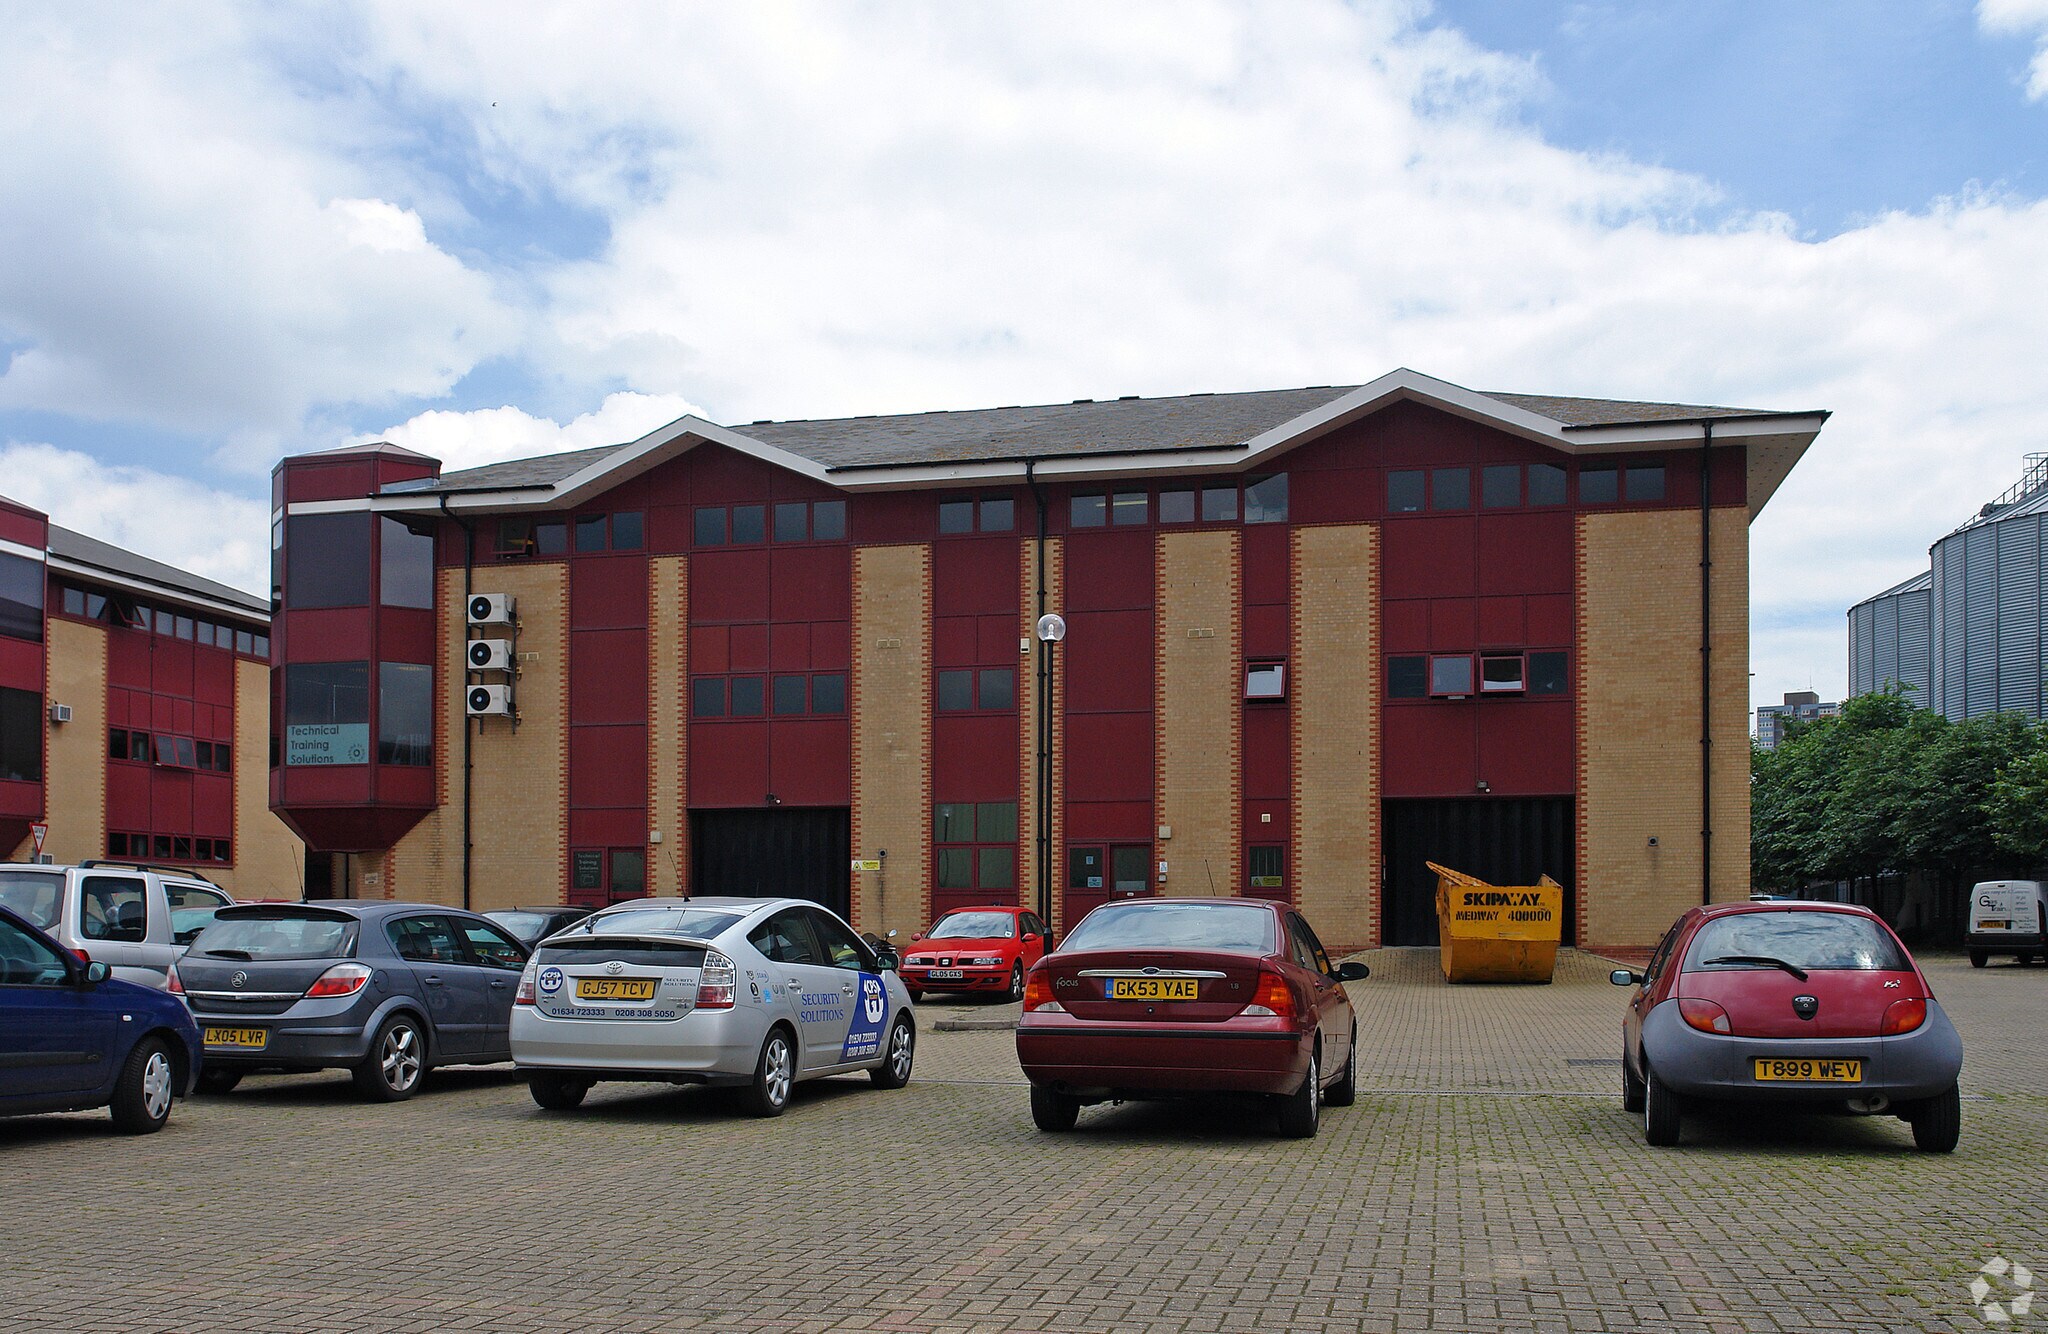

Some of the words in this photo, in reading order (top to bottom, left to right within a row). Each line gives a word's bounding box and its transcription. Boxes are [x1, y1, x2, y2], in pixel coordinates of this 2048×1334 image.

[291, 725, 339, 736] Technical
[291, 740, 329, 751] Training
[291, 754, 334, 764] Solutions
[1455, 910, 1499, 921] MEDWAY
[1507, 910, 1552, 922] 400000
[582, 981, 618, 995] GJ57
[622, 982, 648, 996] TCV
[1115, 981, 1159, 997] GK53
[1163, 981, 1196, 997] YAE
[801, 992, 840, 1006] SECURITY
[551, 1007, 575, 1016] 01634
[577, 1008, 606, 1016] 723333
[615, 1009, 635, 1017] 0208
[637, 1010, 653, 1018] 308
[655, 1010, 676, 1018] 5050
[800, 1009, 844, 1023] SOLUTIONS
[206, 1029, 238, 1043] LX05
[239, 1030, 263, 1044] LVR
[1759, 1061, 1814, 1077] T899
[1817, 1061, 1858, 1078] WEV
